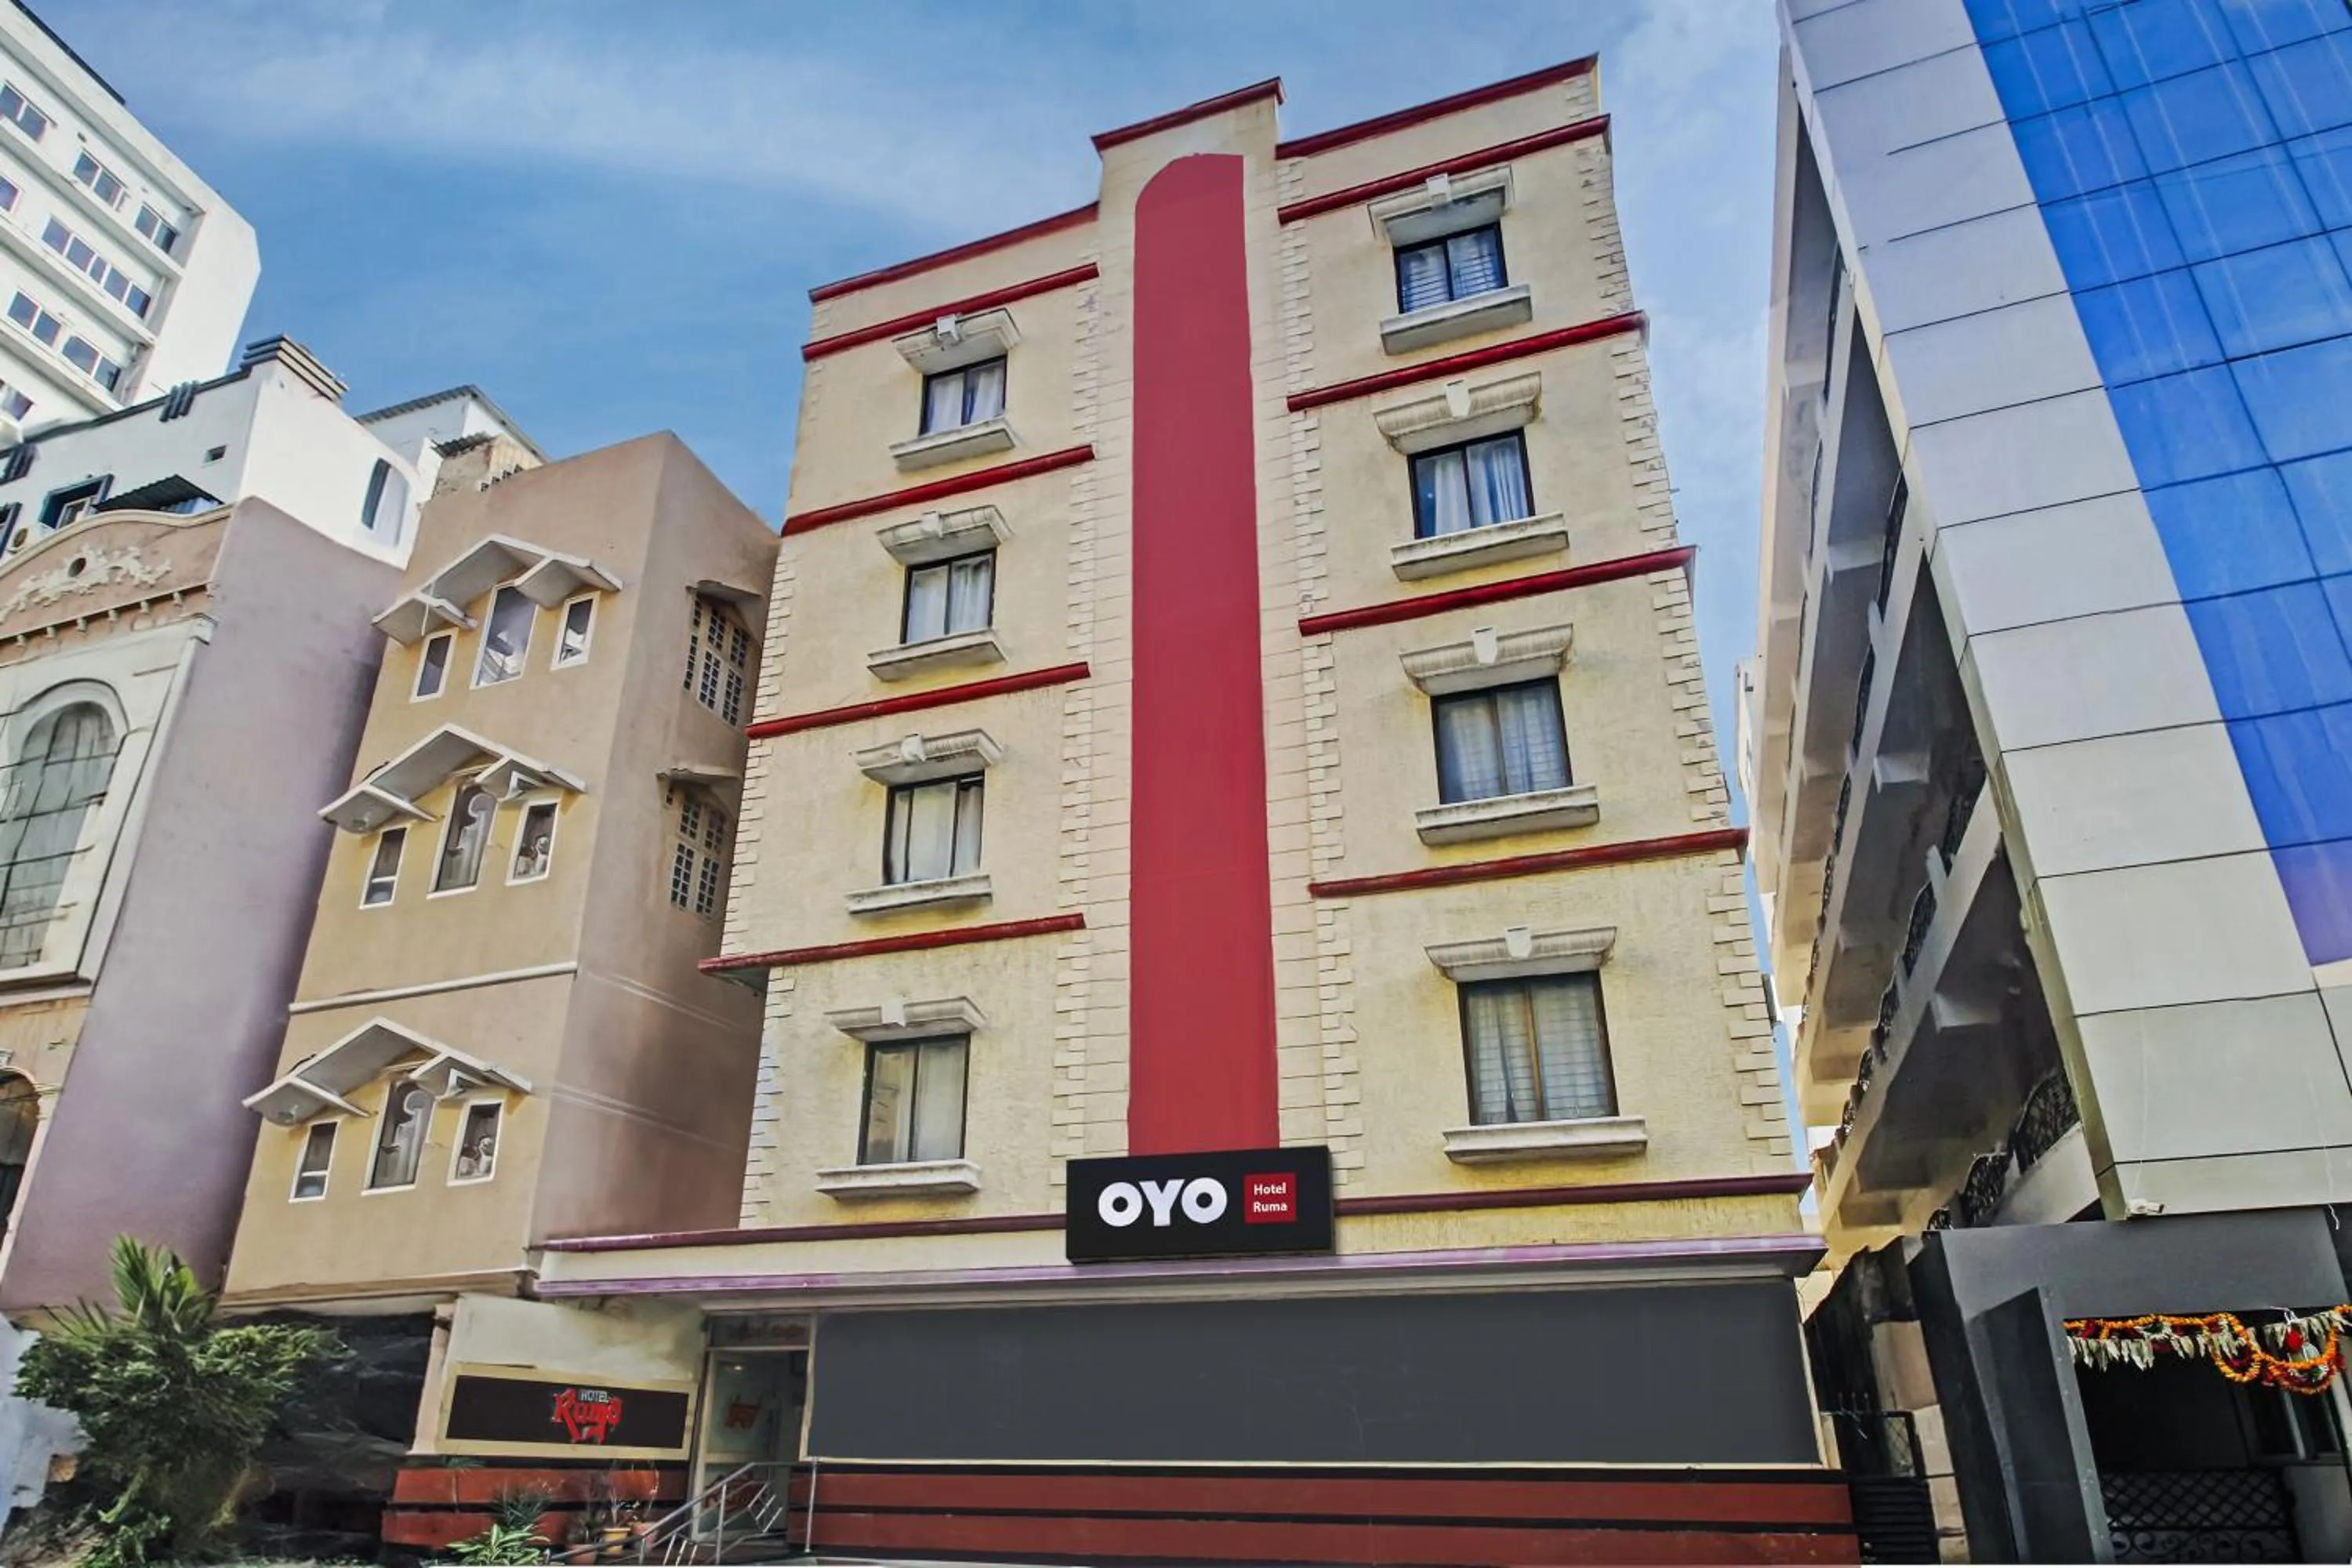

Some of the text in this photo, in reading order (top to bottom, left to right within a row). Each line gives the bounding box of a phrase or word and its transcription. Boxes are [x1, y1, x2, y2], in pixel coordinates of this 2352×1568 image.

[1254, 1181, 1287, 1196] Hotel
[1098, 1178, 1228, 1227] OYO
[1254, 1201, 1288, 1213] Ruma
